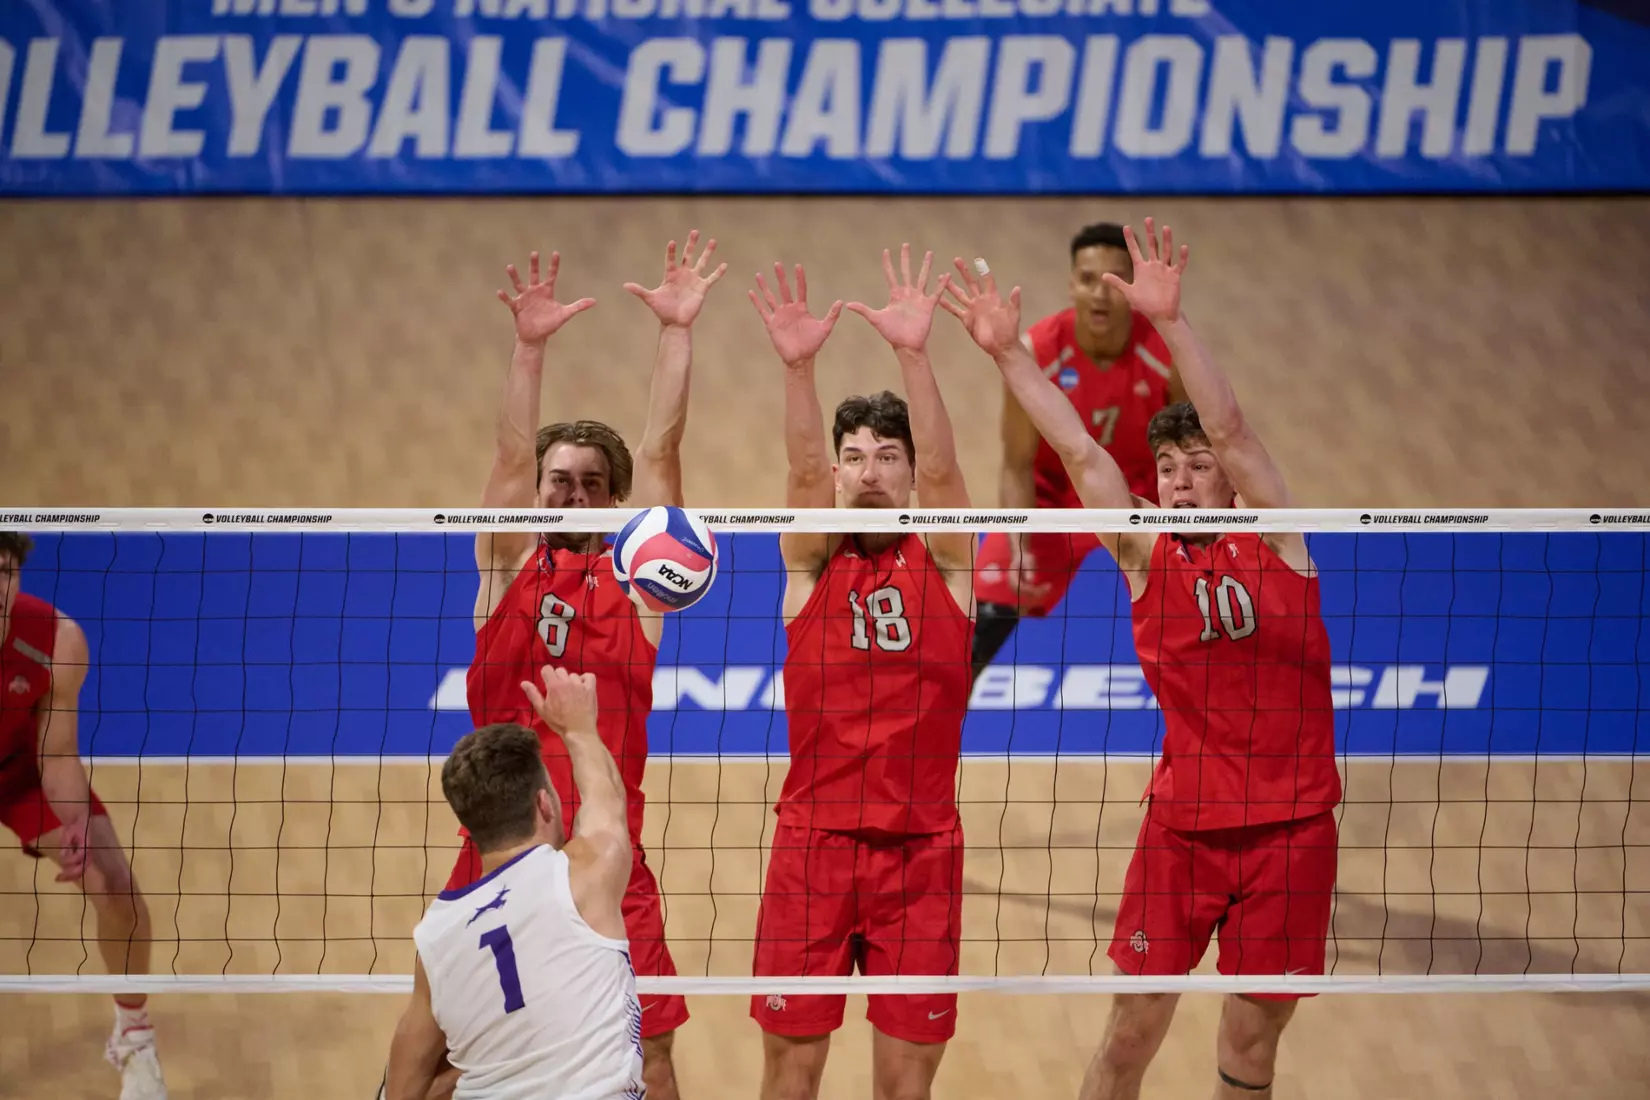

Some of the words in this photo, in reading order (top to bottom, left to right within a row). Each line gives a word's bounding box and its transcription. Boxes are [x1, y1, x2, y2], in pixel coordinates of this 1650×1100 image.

[0, 34, 580, 160] LLEYBALL
[615, 33, 1592, 160] CHAMPIONSHIP
[1092, 406, 1121, 446] 7
[35, 514, 101, 523] CHAMPIONSHIP
[216, 514, 265, 524] VOLLEYBALL
[266, 514, 333, 524] CHAMPIONSHIP
[447, 515, 496, 524] VOLLEYBALL
[498, 515, 564, 524] CHAMPIONSHIP
[729, 515, 795, 524] CHAMPIONSHIP
[912, 515, 961, 524] VOLLEYBALL
[962, 515, 1028, 524] CHAMPIONSHIP
[1142, 515, 1191, 524] VOLLEYBALL
[1193, 515, 1259, 524] CHAMPIONSHIP
[1373, 515, 1422, 524] VOLLEYBALL
[1423, 515, 1489, 524] CHAMPIONSHIP
[658, 563, 694, 591] NCAA
[1193, 574, 1257, 642] 10
[537, 592, 577, 659] 8
[848, 584, 912, 653] 18
[479, 924, 526, 1014] 1
